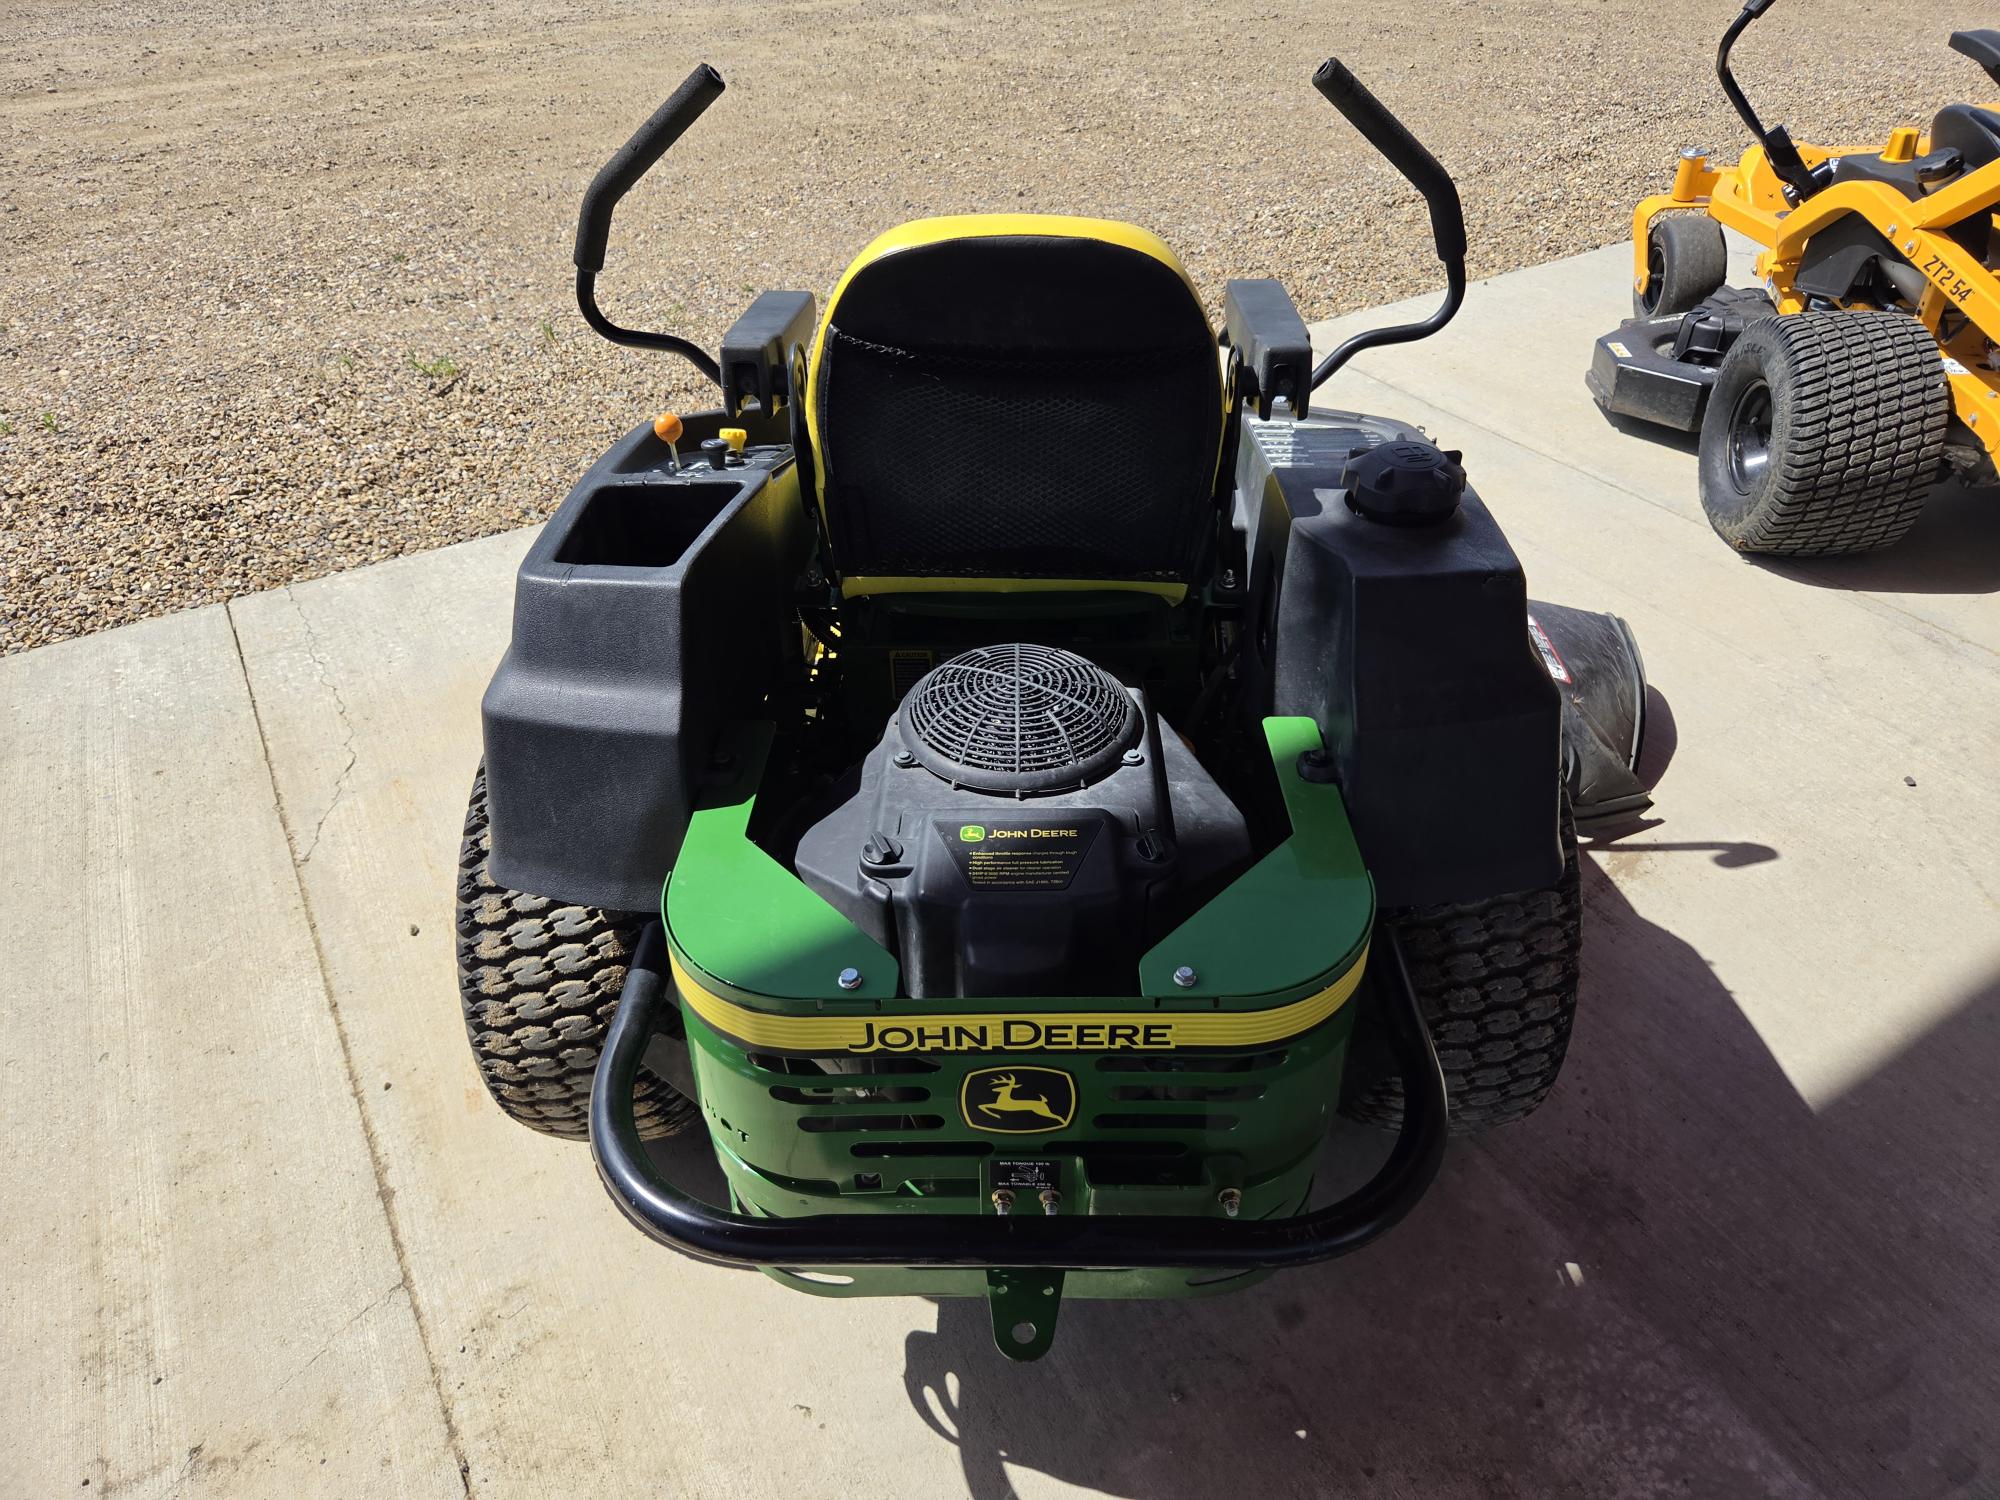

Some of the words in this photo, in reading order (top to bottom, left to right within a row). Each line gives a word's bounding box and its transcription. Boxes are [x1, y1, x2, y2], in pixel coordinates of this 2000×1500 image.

[1923, 254, 1955, 287] ZT2
[988, 829, 1028, 839] JOHN
[1030, 829, 1078, 838] DEERE
[848, 1022, 990, 1051] JOHN
[1002, 1019, 1175, 1050] DEERE
